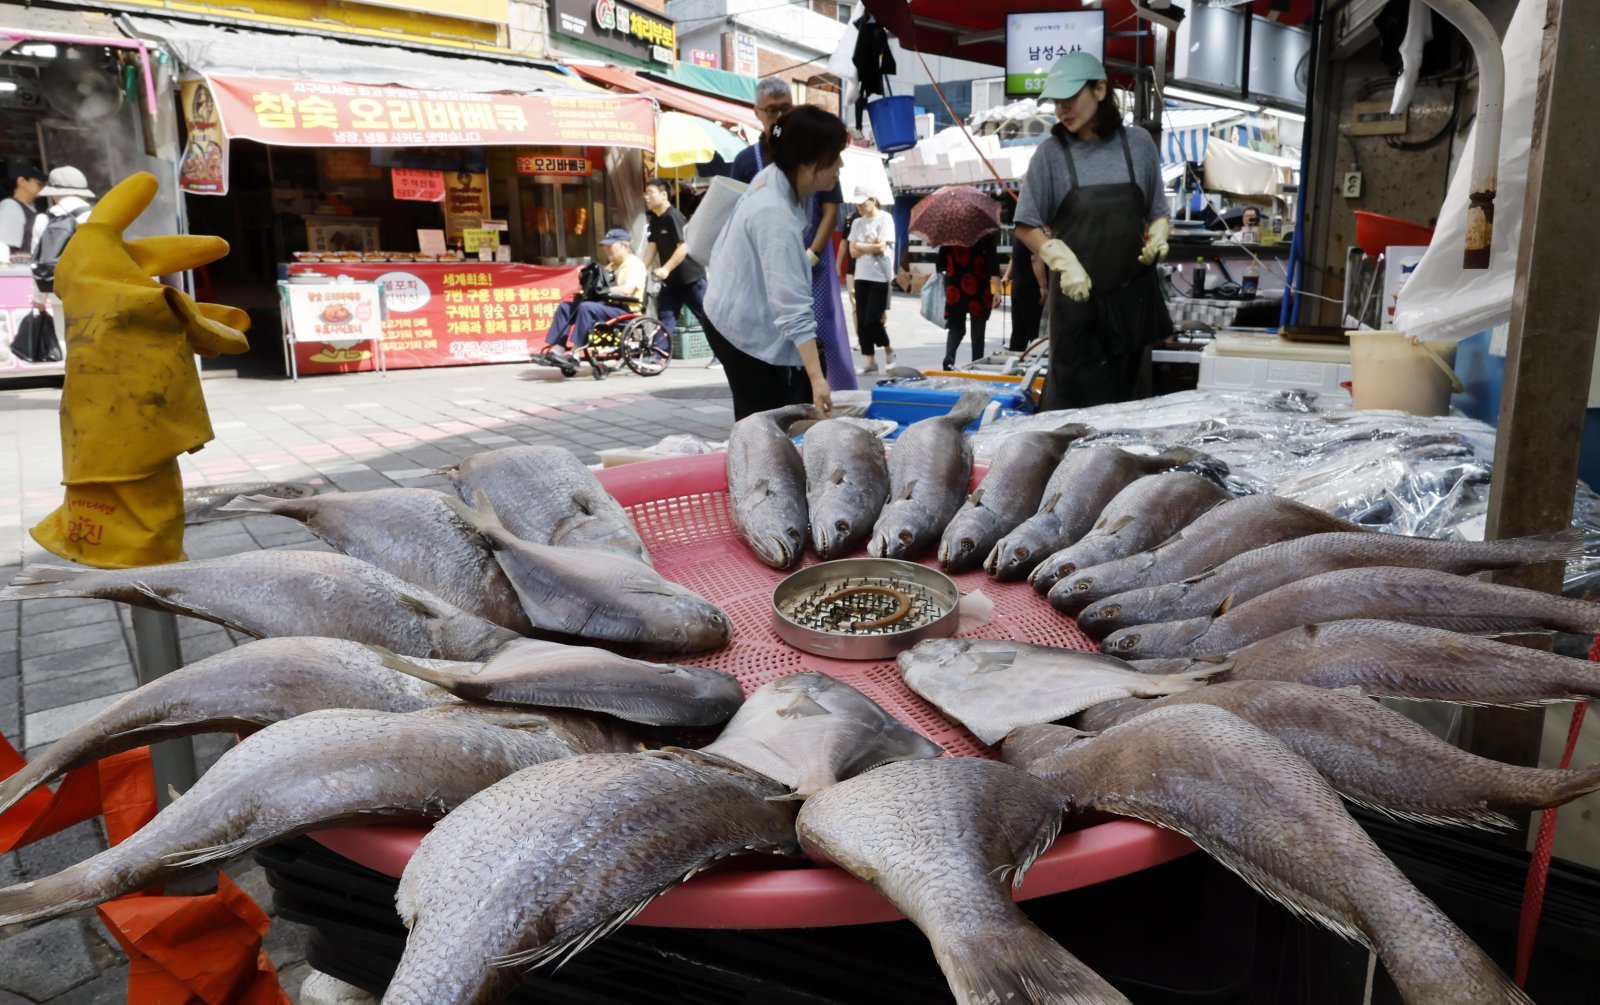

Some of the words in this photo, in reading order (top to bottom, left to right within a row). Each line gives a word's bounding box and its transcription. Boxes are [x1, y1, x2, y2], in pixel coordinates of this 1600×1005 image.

[630, 12, 673, 47] 체리부로
[252, 91, 340, 129] 참숯
[349, 98, 529, 132] 오리바베큐
[534, 158, 586, 172] 오리바베큐
[443, 272, 492, 286] 세계최초!
[445, 304, 480, 319] 구워낸
[482, 303, 505, 319] 참숯
[508, 302, 529, 318] 오리
[447, 320, 481, 334] 가족과
